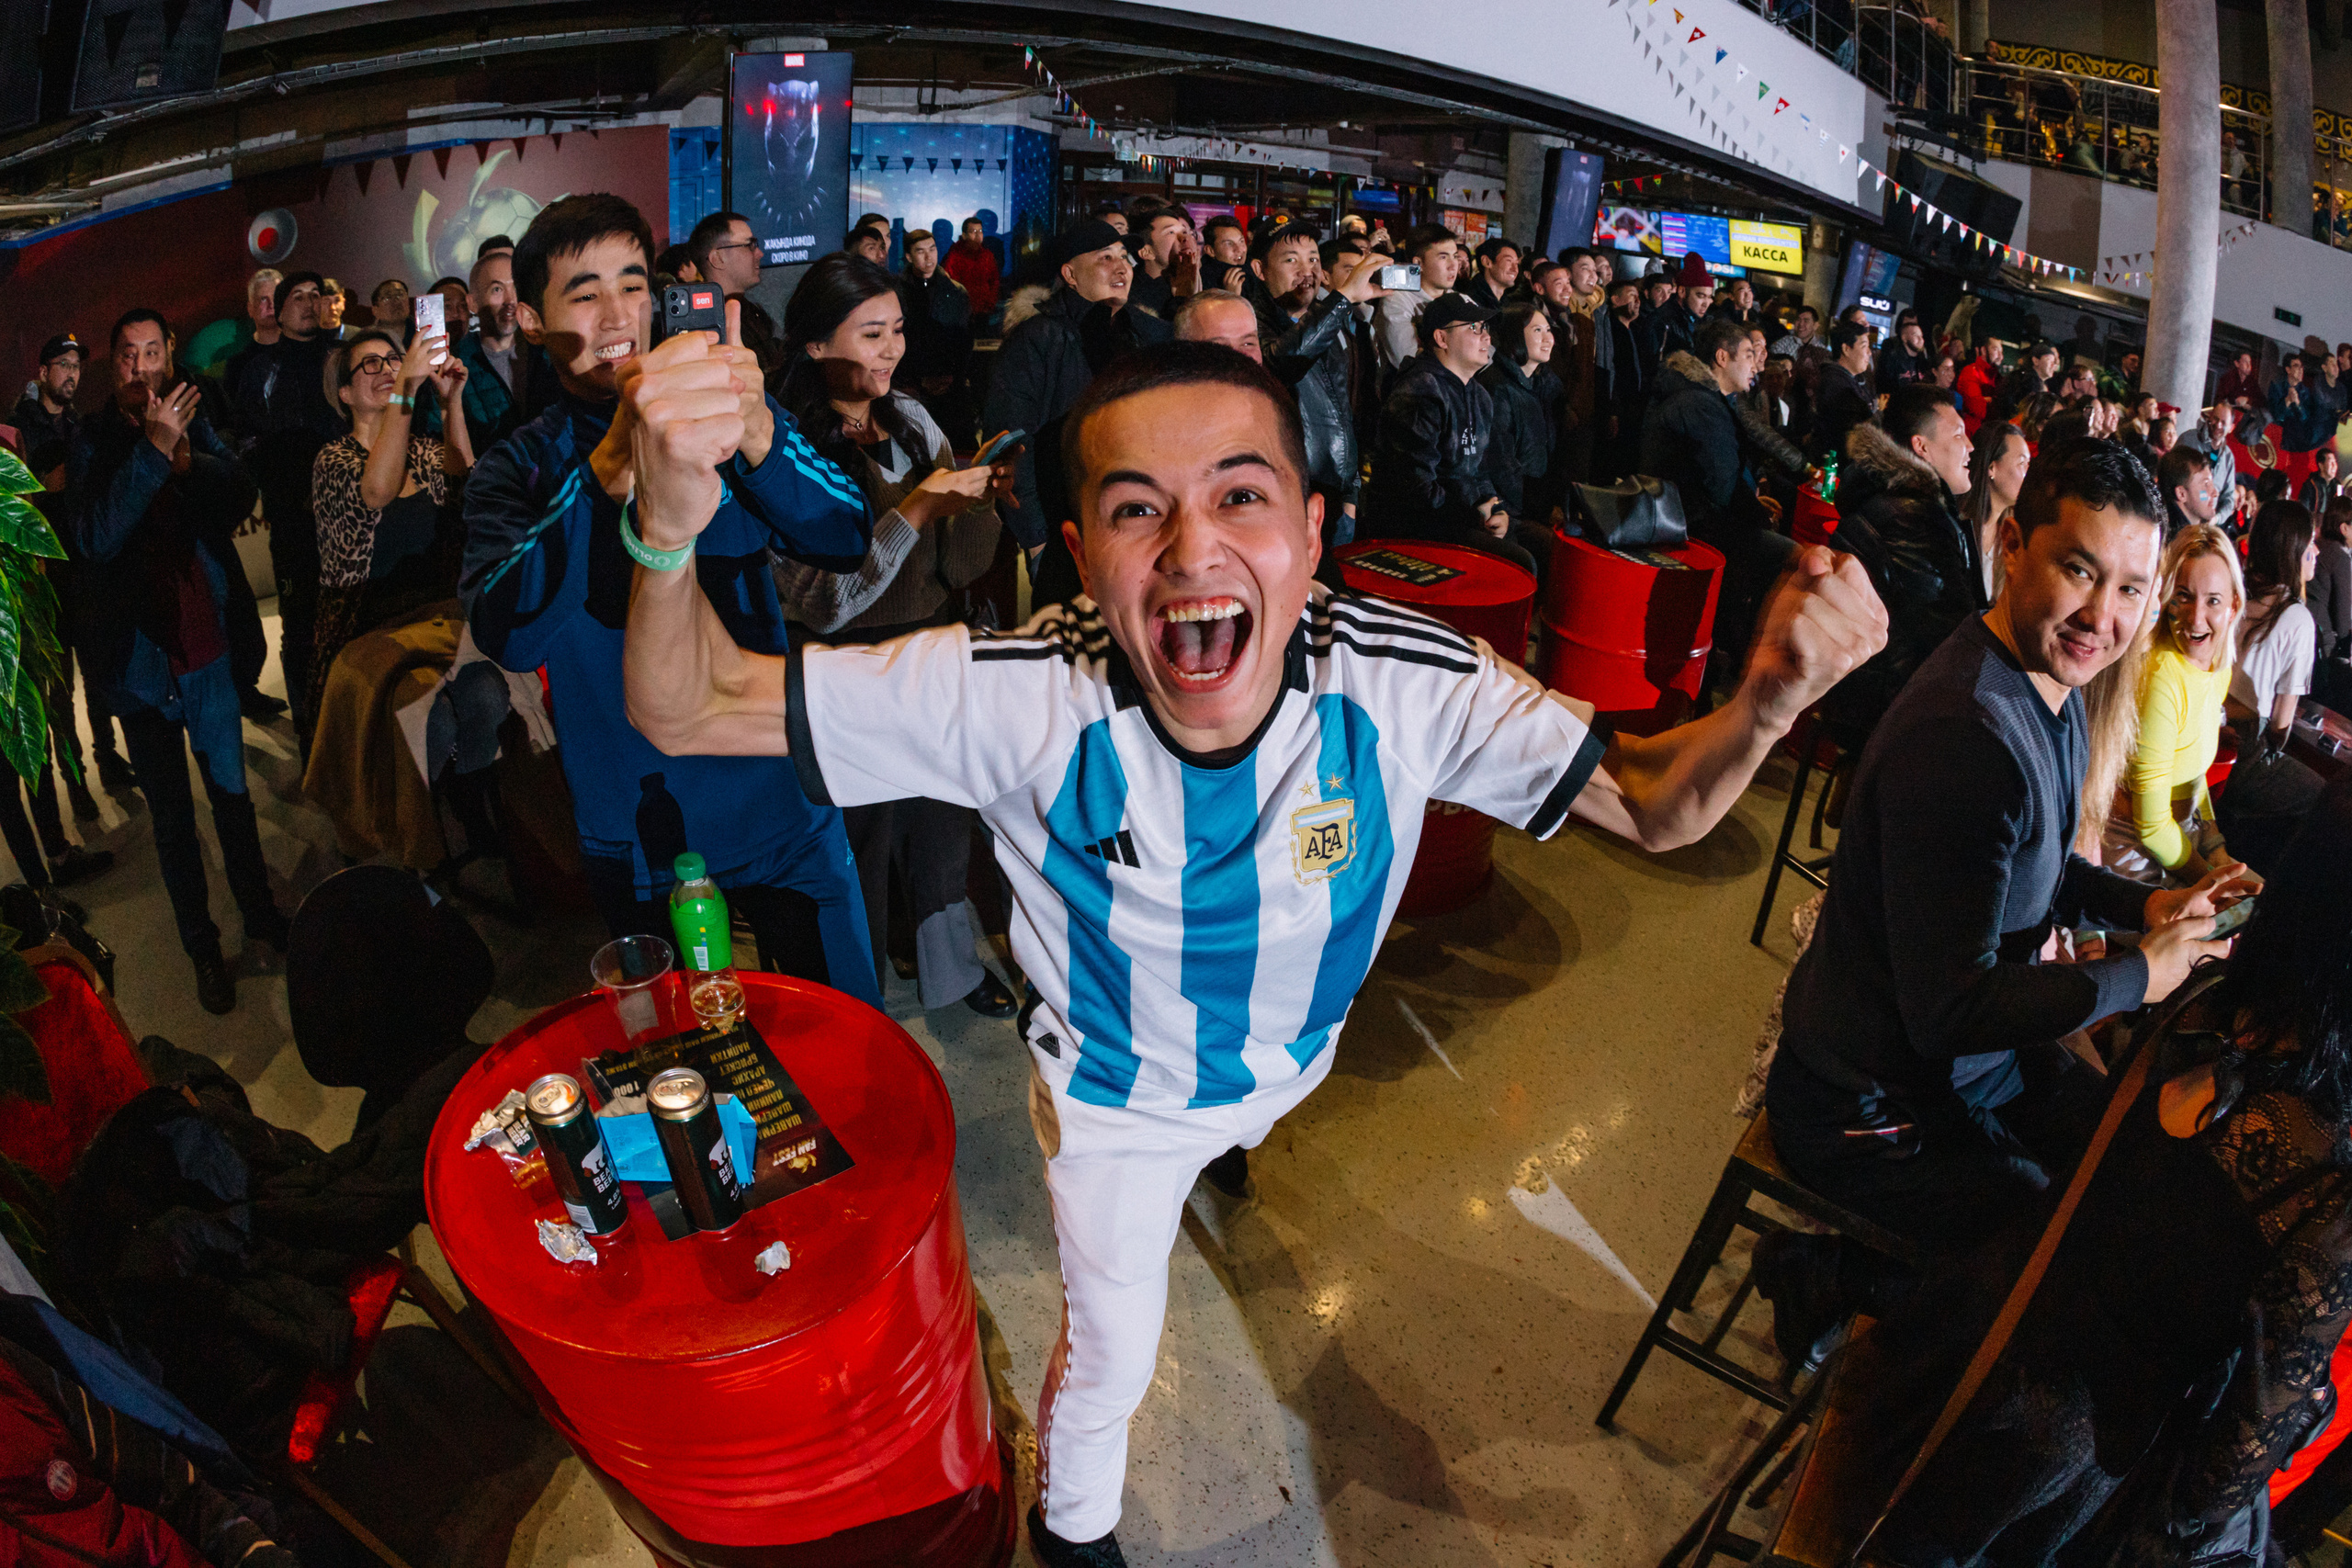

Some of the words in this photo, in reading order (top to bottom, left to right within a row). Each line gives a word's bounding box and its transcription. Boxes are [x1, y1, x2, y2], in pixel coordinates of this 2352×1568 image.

[1743, 245, 1789, 263] КАССА
[1704, 261, 1735, 275] epsi
[695, 297, 710, 305] sen
[1305, 823, 1343, 860] AFA
[709, 1042, 751, 1064] НАПИТКИ
[719, 1053, 759, 1077] БРИСКЕТ
[731, 1065, 766, 1086] АРАХИС
[745, 1077, 775, 1097] ЧЕЧЕЛ
[746, 1089, 784, 1112] ПАНИНИ
[772, 1145, 797, 1167] FEST
[797, 1136, 817, 1156] FAN
[593, 1167, 611, 1187] BEA
[597, 1174, 614, 1193] BEE
